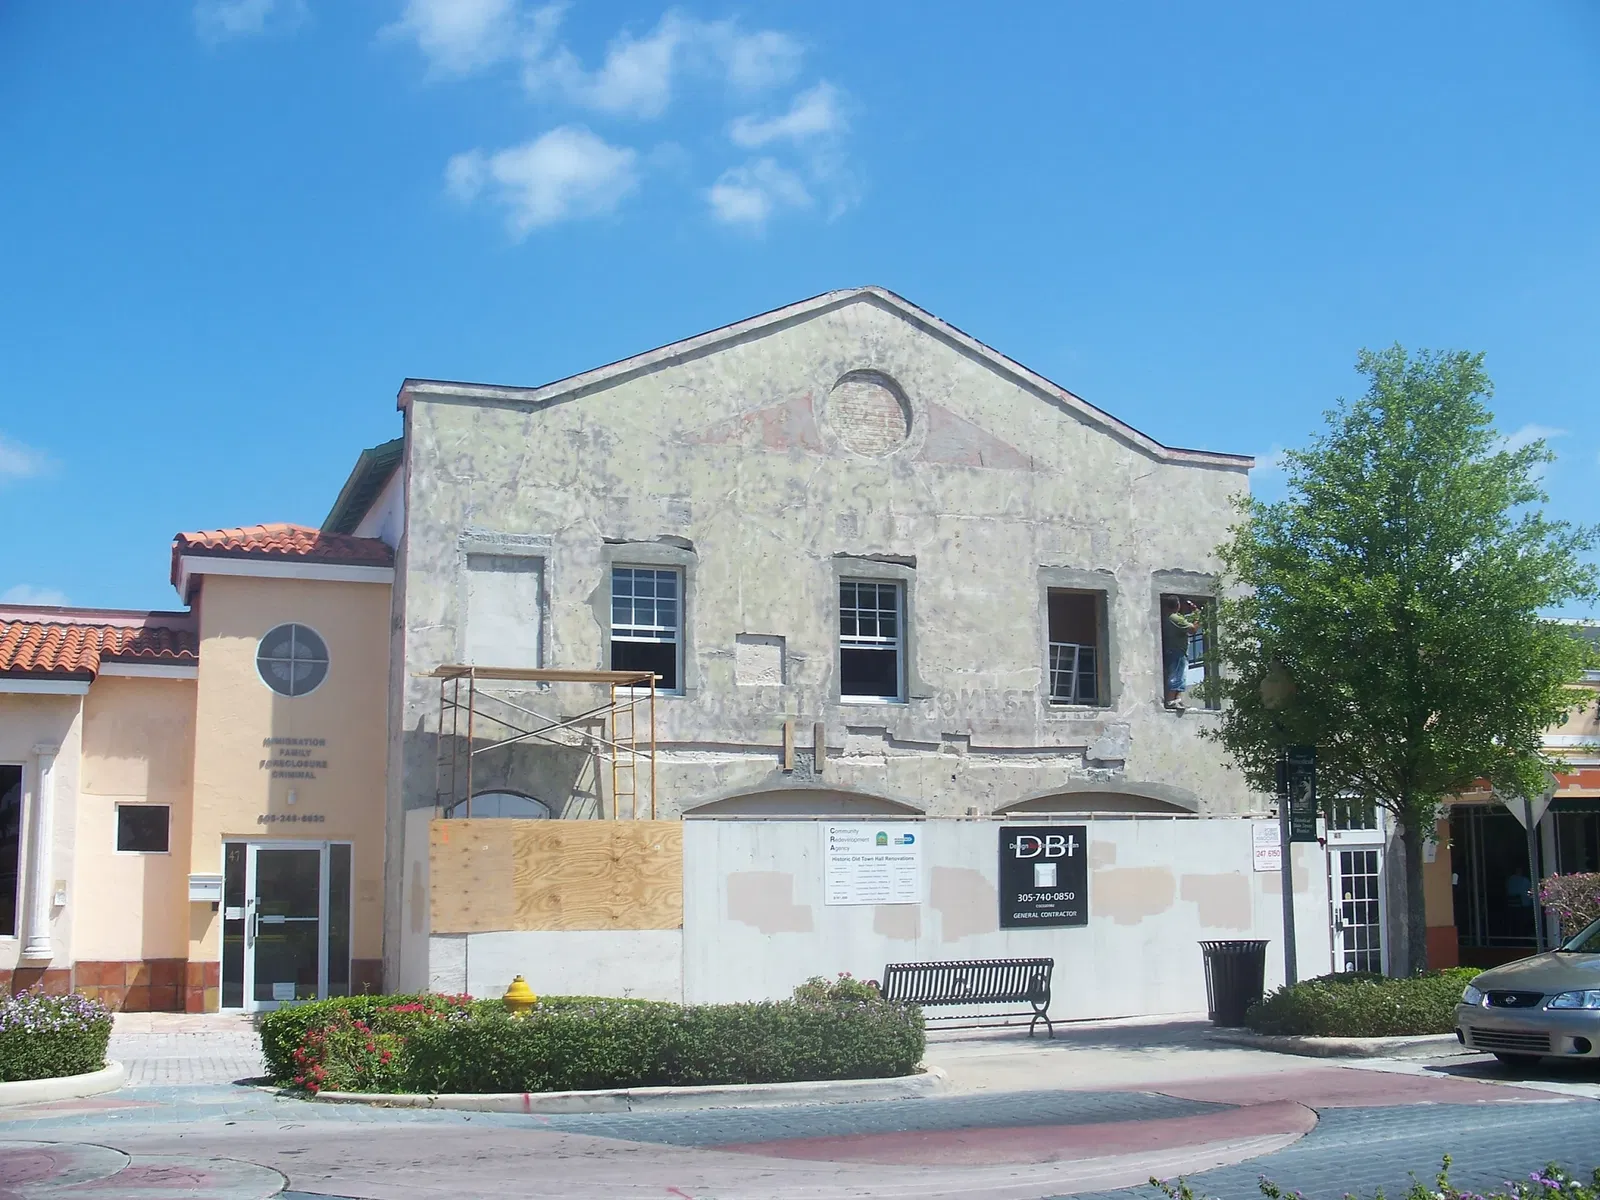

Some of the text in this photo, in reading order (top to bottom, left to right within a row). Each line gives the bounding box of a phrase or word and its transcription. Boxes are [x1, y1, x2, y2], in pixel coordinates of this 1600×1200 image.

[263, 737, 326, 748] IMMIGRATION
[279, 749, 312, 757] FAMILY
[259, 759, 328, 770] FORECLOSURE
[271, 771, 317, 779] CRIMINAL
[829, 827, 860, 835] Community
[1015, 834, 1074, 859] DBI
[228, 850, 240, 863] 47
[1017, 892, 1075, 902] 305-740-0850
[1013, 910, 1078, 919] GENERAL CONTRACTOR
